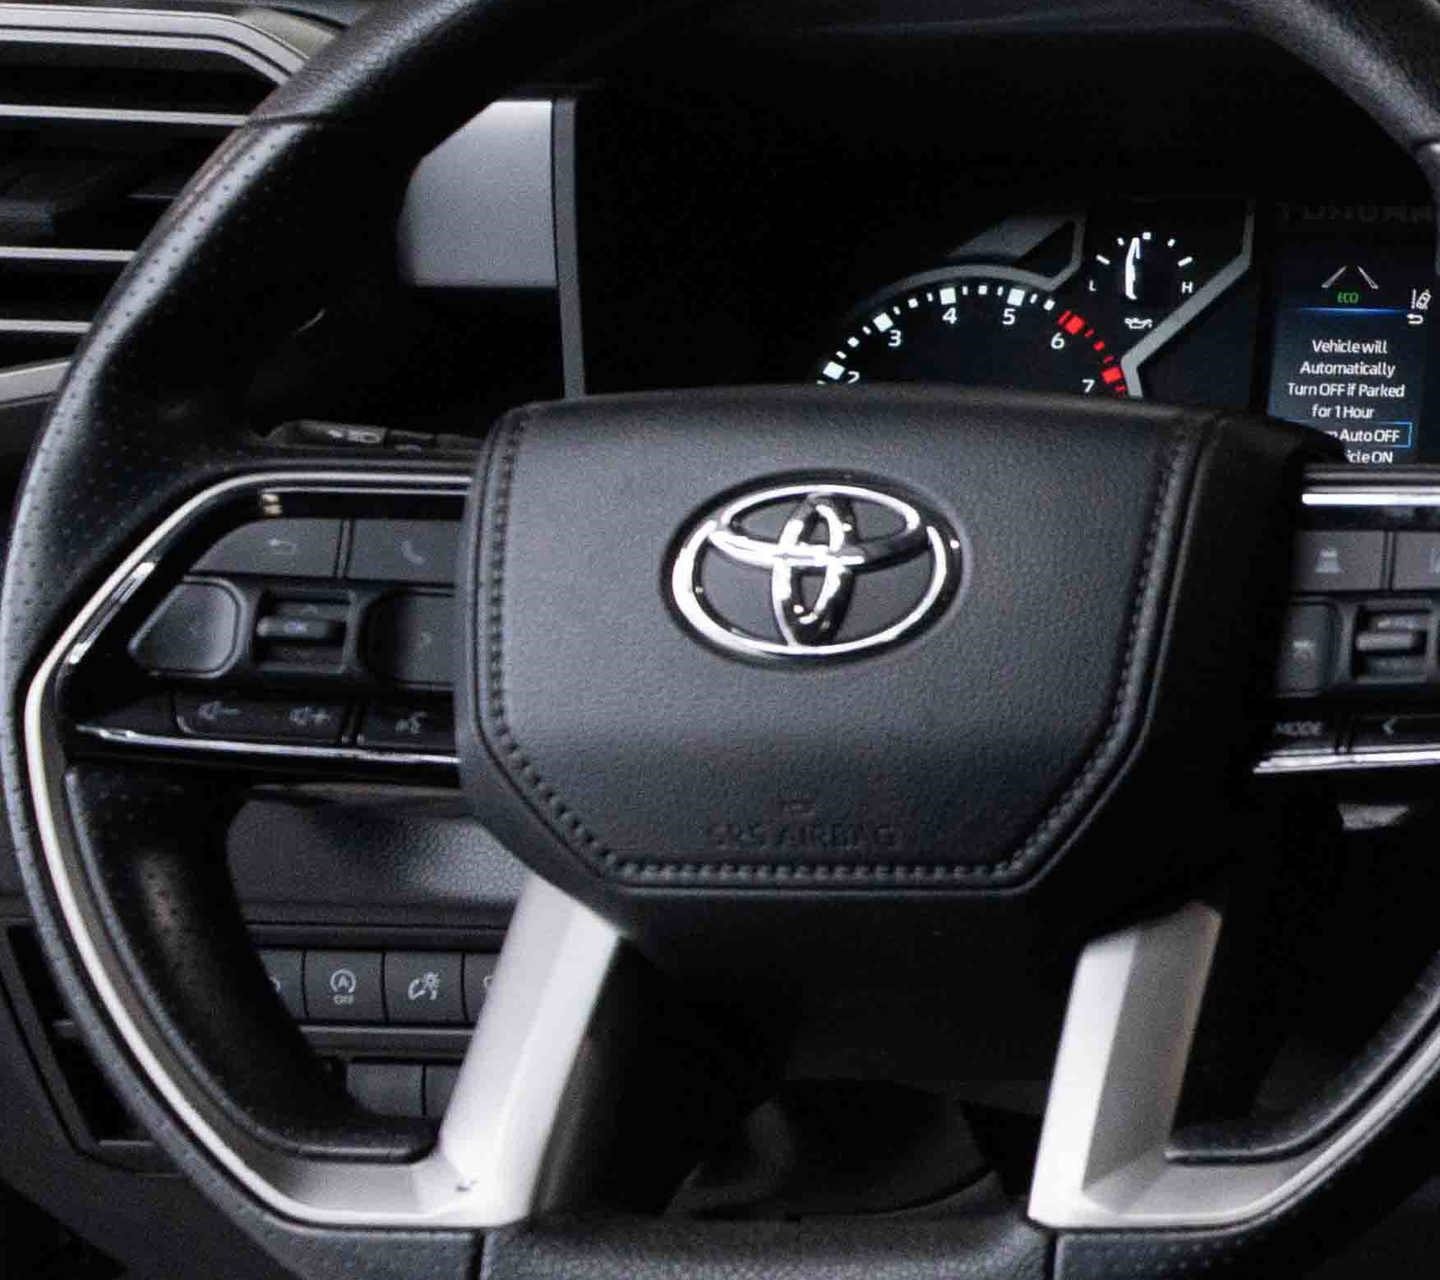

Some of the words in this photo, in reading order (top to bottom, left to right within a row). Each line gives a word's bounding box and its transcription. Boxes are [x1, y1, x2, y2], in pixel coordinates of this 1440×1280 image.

[1088, 279, 1097, 292] L
[1181, 280, 1193, 294] H
[1336, 290, 1362, 305] ECO
[942, 306, 958, 325] 4
[1001, 308, 1017, 326] 5
[886, 329, 903, 348] 3
[1050, 331, 1066, 350] 6
[1311, 339, 1361, 355] Vehicle
[1361, 339, 1389, 355] will
[1299, 360, 1397, 379] Automatically
[1080, 377, 1096, 394] 7
[1287, 381, 1318, 397] Turn
[1318, 382, 1346, 398] OFF
[1346, 381, 1358, 397] if
[1358, 382, 1406, 399] Parked
[1311, 403, 1334, 418] for
[1343, 403, 1376, 419] Hour
[1338, 429, 1373, 444] Auto
[1374, 429, 1401, 444] OFF
[1370, 451, 1394, 464] ON
